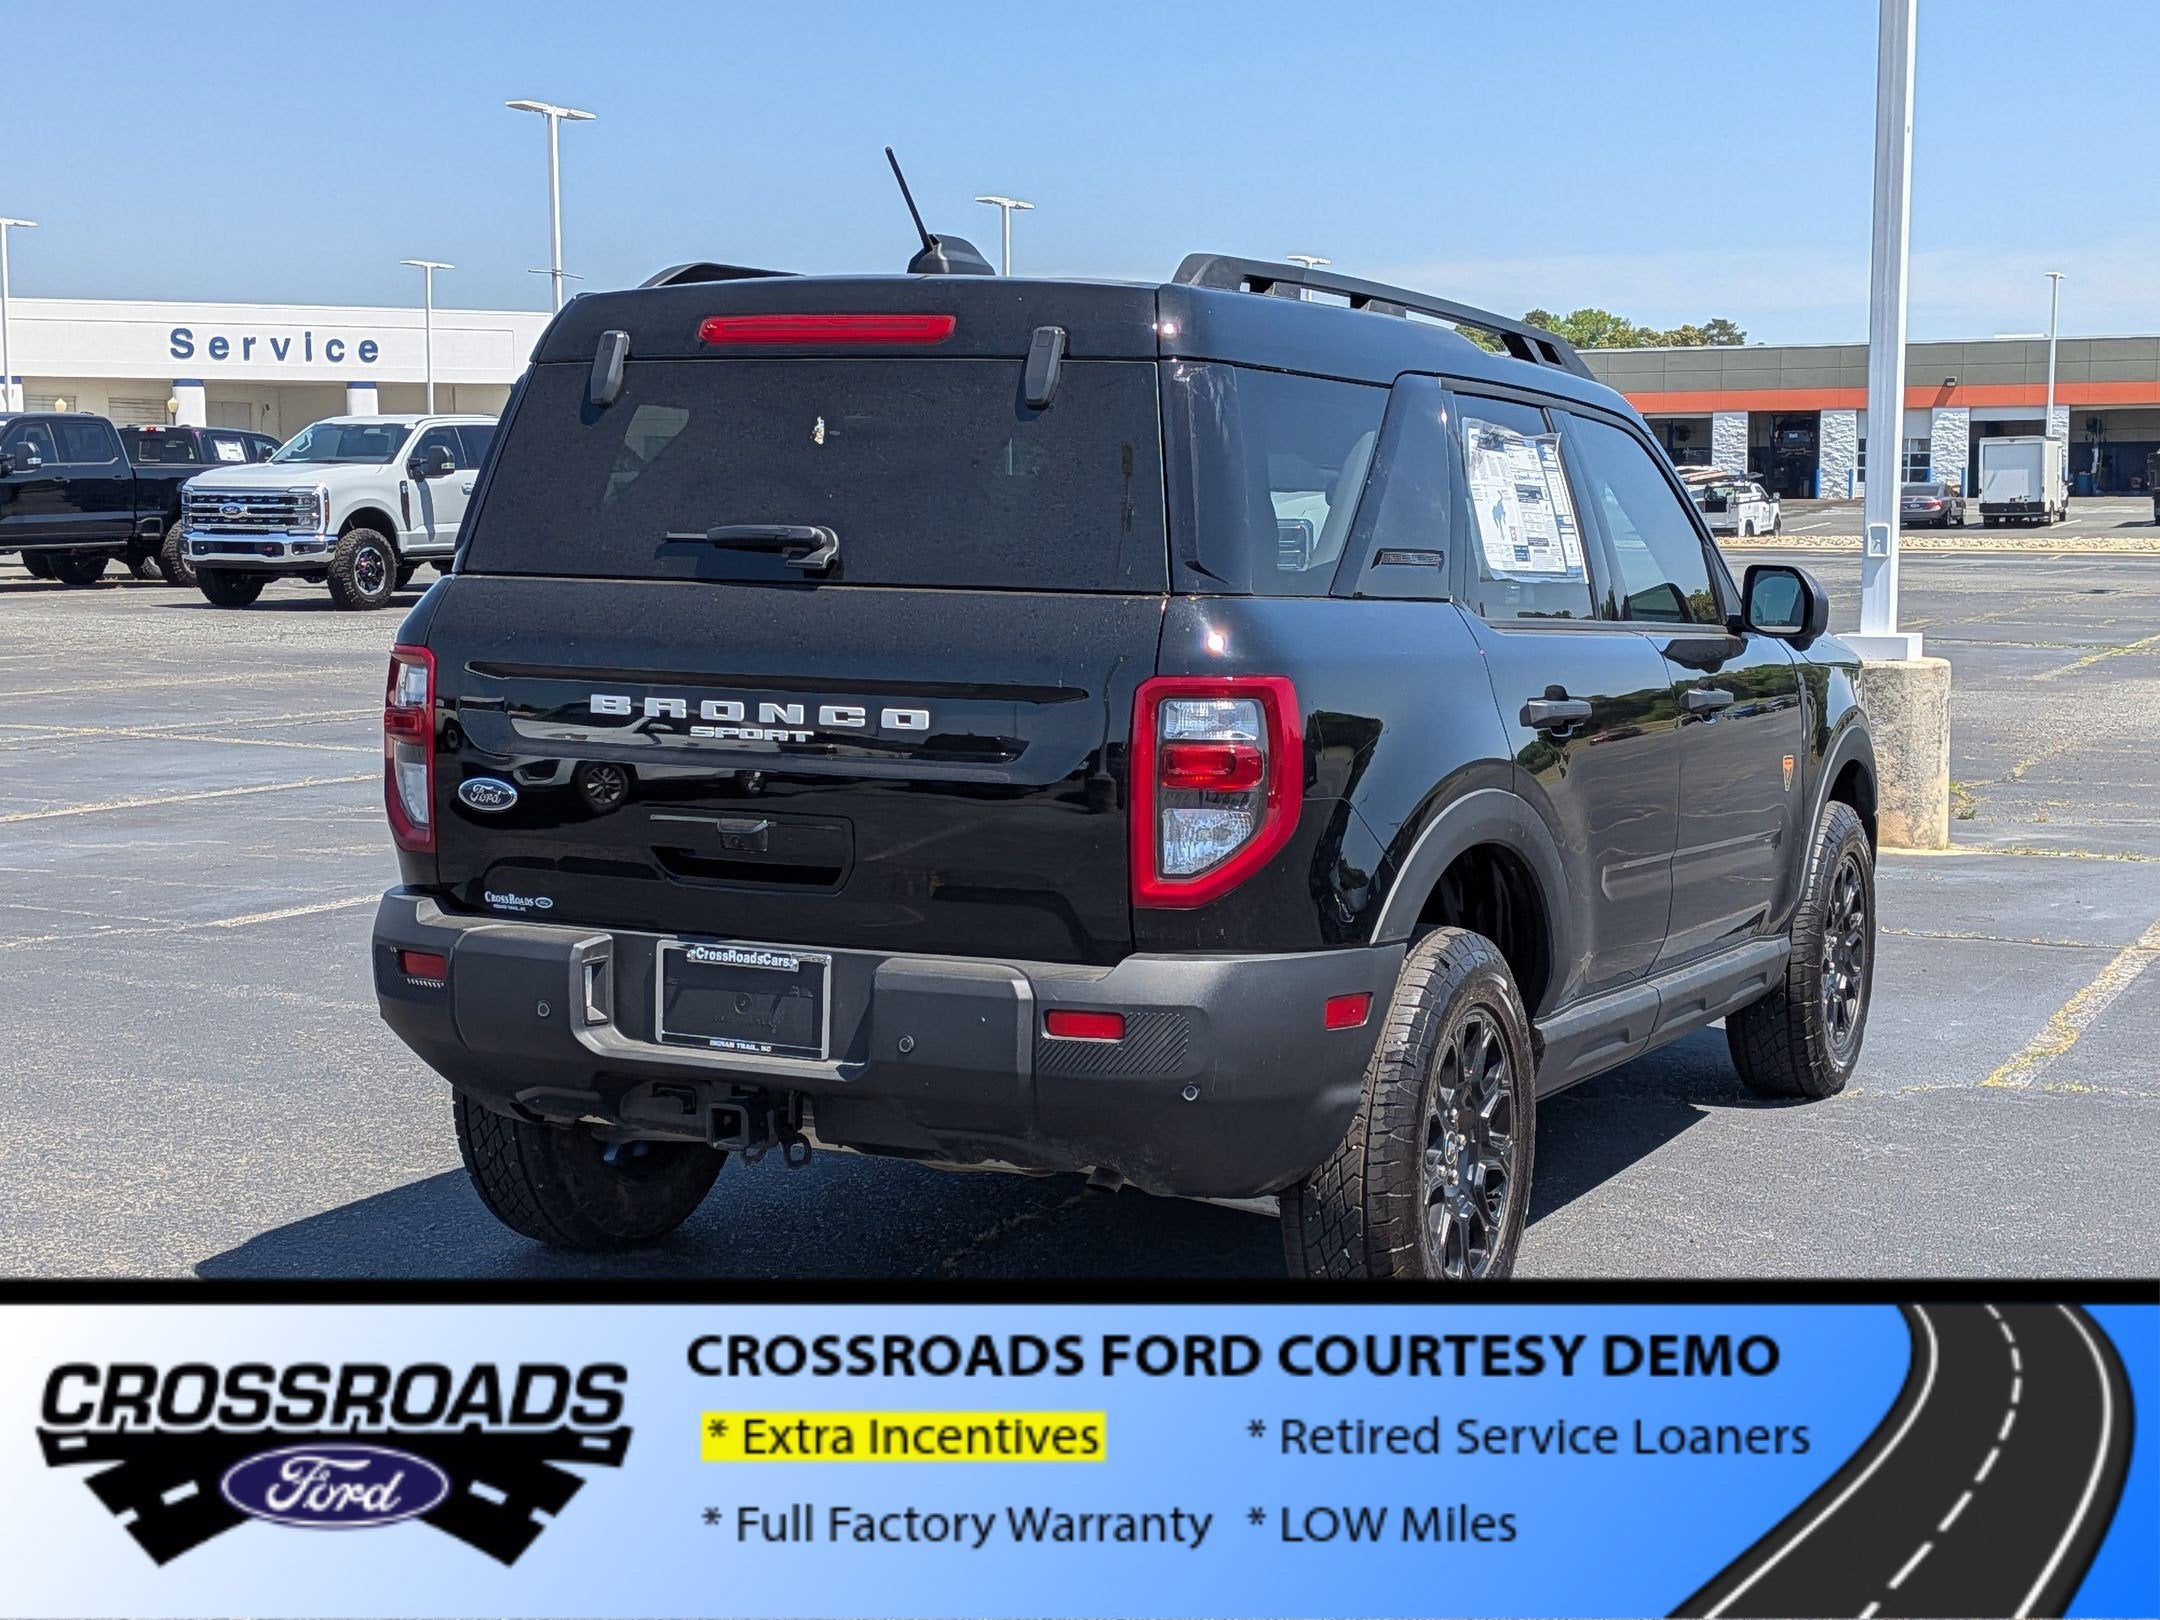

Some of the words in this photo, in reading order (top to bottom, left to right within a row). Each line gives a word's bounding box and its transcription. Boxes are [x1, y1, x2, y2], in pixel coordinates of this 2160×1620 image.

[169, 327, 379, 363] Service
[590, 693, 930, 730] BRONCO
[689, 725, 815, 743] SPORT
[470, 784, 502, 804] Ford
